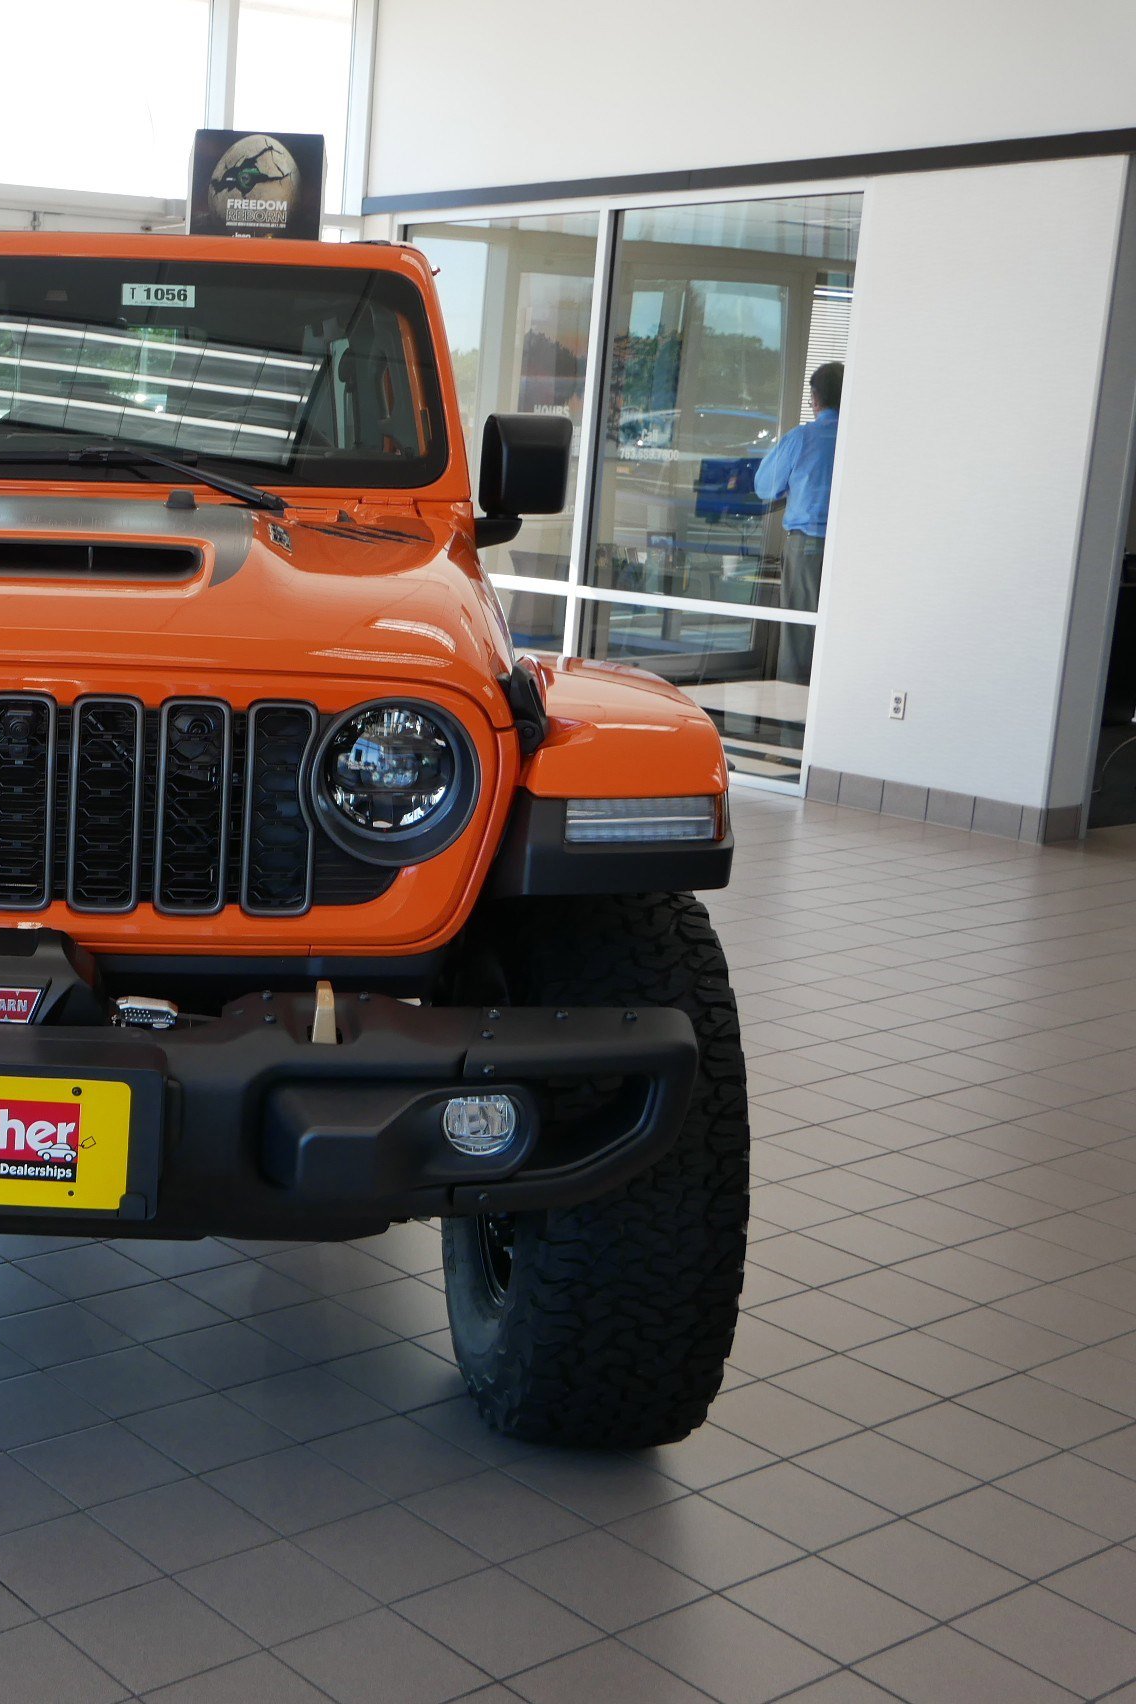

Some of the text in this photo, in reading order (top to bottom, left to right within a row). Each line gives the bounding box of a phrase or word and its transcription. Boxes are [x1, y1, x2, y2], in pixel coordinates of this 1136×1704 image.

[227, 199, 288, 211] FREEDOM
[225, 209, 288, 223] REBORN
[143, 287, 188, 302] 1056
[533, 404, 570, 417] HOURS
[0, 1162, 72, 1180] Dealerships
